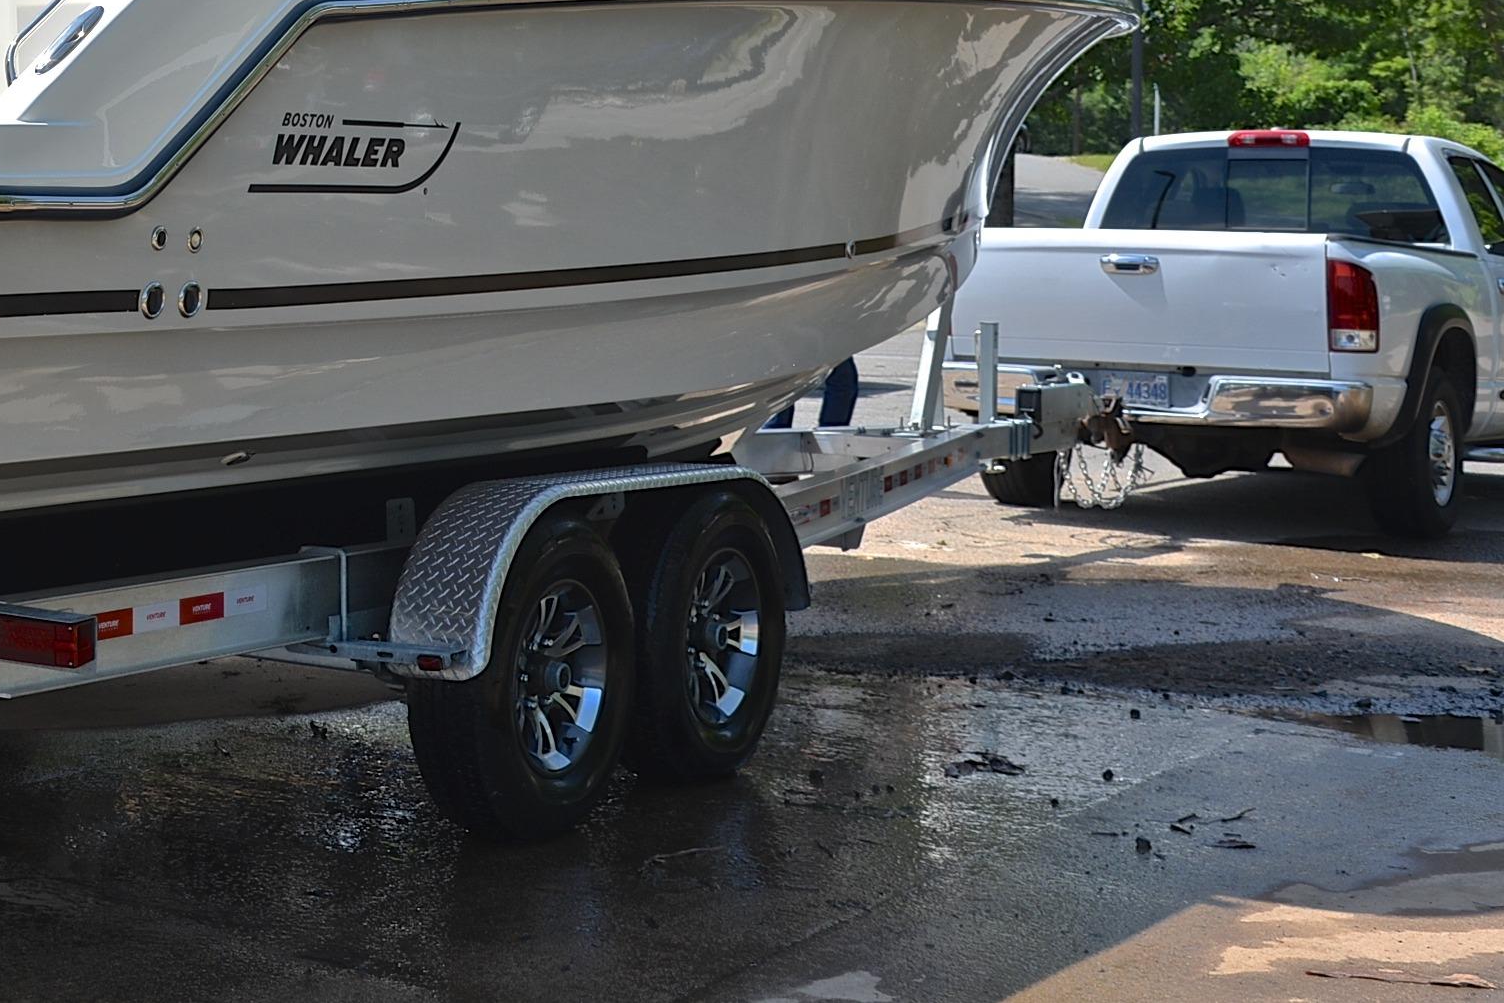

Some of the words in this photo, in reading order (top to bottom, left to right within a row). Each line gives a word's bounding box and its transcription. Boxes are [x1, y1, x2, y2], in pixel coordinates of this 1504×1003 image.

[282, 112, 334, 129] BOSTON
[272, 133, 405, 168] WHALER
[236, 595, 255, 604] VENTURE
[192, 603, 212, 614] VENTURE
[147, 611, 167, 621] VENTURE
[98, 619, 120, 629] VENTURE
